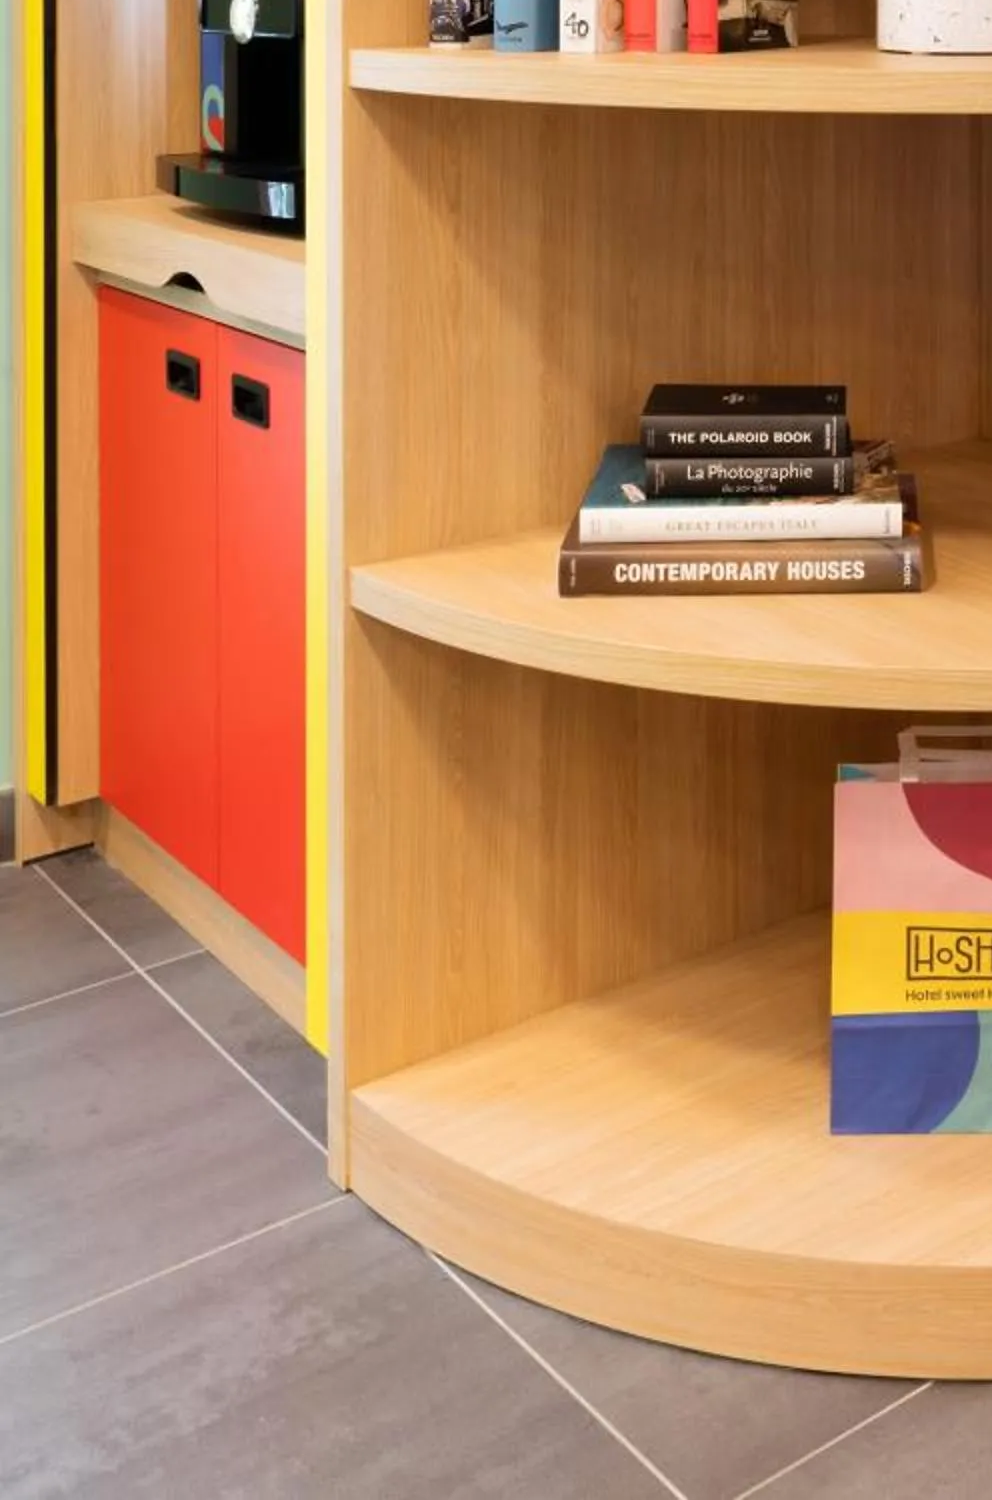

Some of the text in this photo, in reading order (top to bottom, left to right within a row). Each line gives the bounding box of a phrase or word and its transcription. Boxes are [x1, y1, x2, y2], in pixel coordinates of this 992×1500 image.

[668, 432, 696, 444] THE
[700, 431, 769, 444] POLAROID
[773, 431, 813, 443] BOOK
[687, 464, 704, 481] La
[708, 462, 813, 484] Photographie
[614, 560, 866, 583] CONTEMPORARY HOUSES
[905, 988, 942, 1002] Hotel
[945, 988, 985, 1000] sweet
